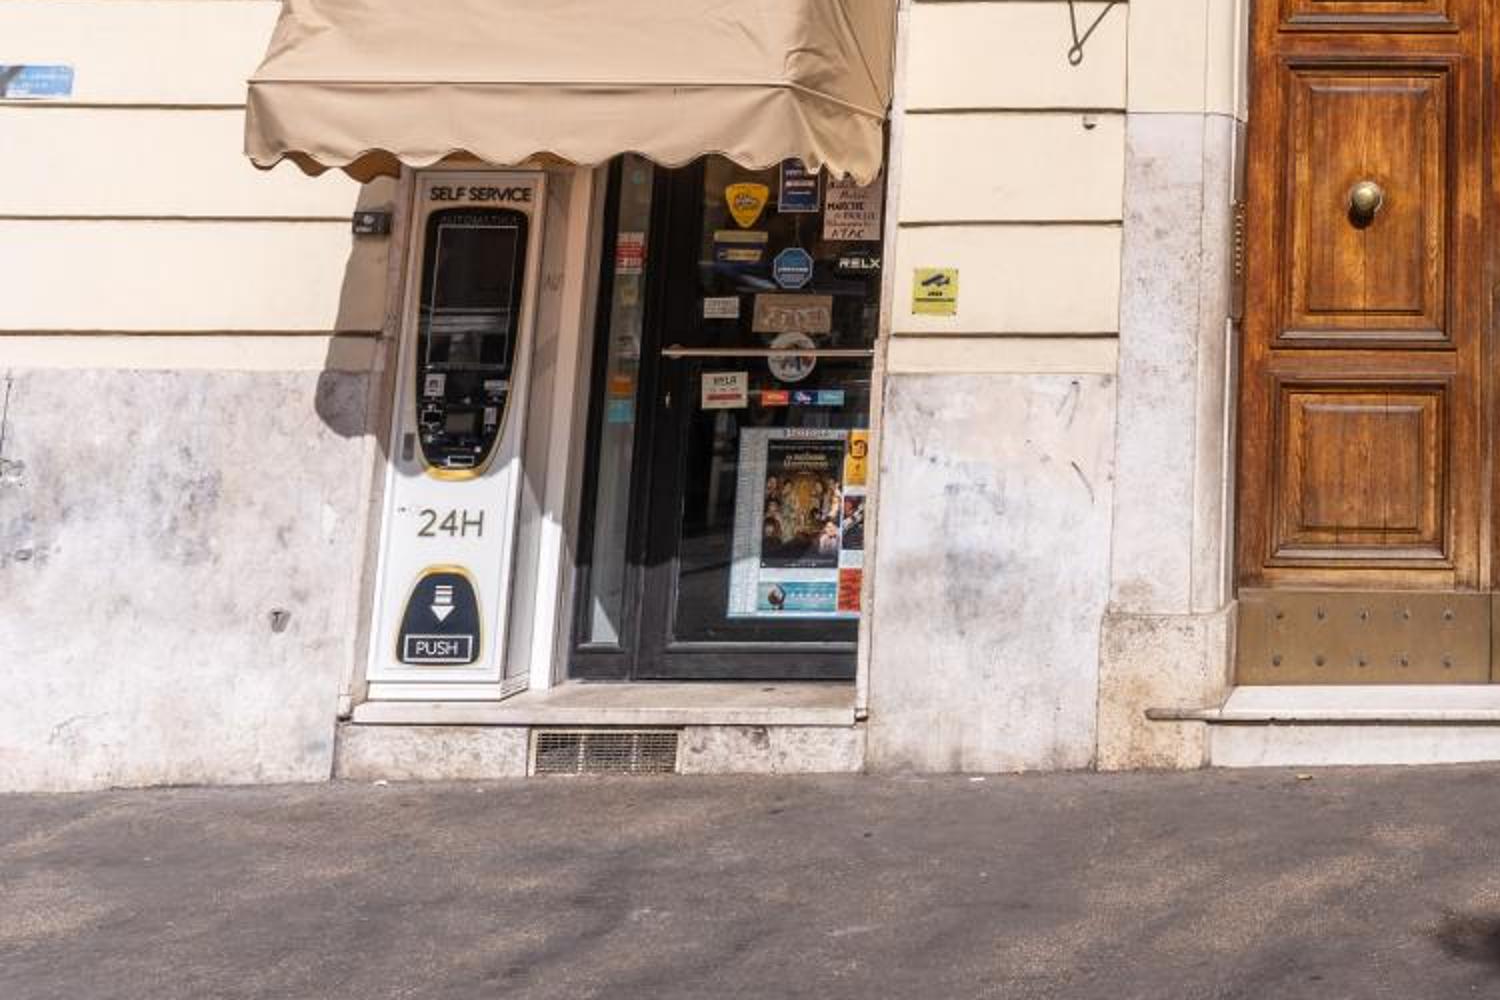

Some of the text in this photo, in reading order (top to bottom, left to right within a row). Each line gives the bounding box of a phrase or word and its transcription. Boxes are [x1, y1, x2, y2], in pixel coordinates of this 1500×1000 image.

[430, 187, 532, 201] SELF SERVICE
[838, 257, 881, 269] RELX
[417, 509, 485, 538] 24H
[415, 640, 458, 657] PUSH
